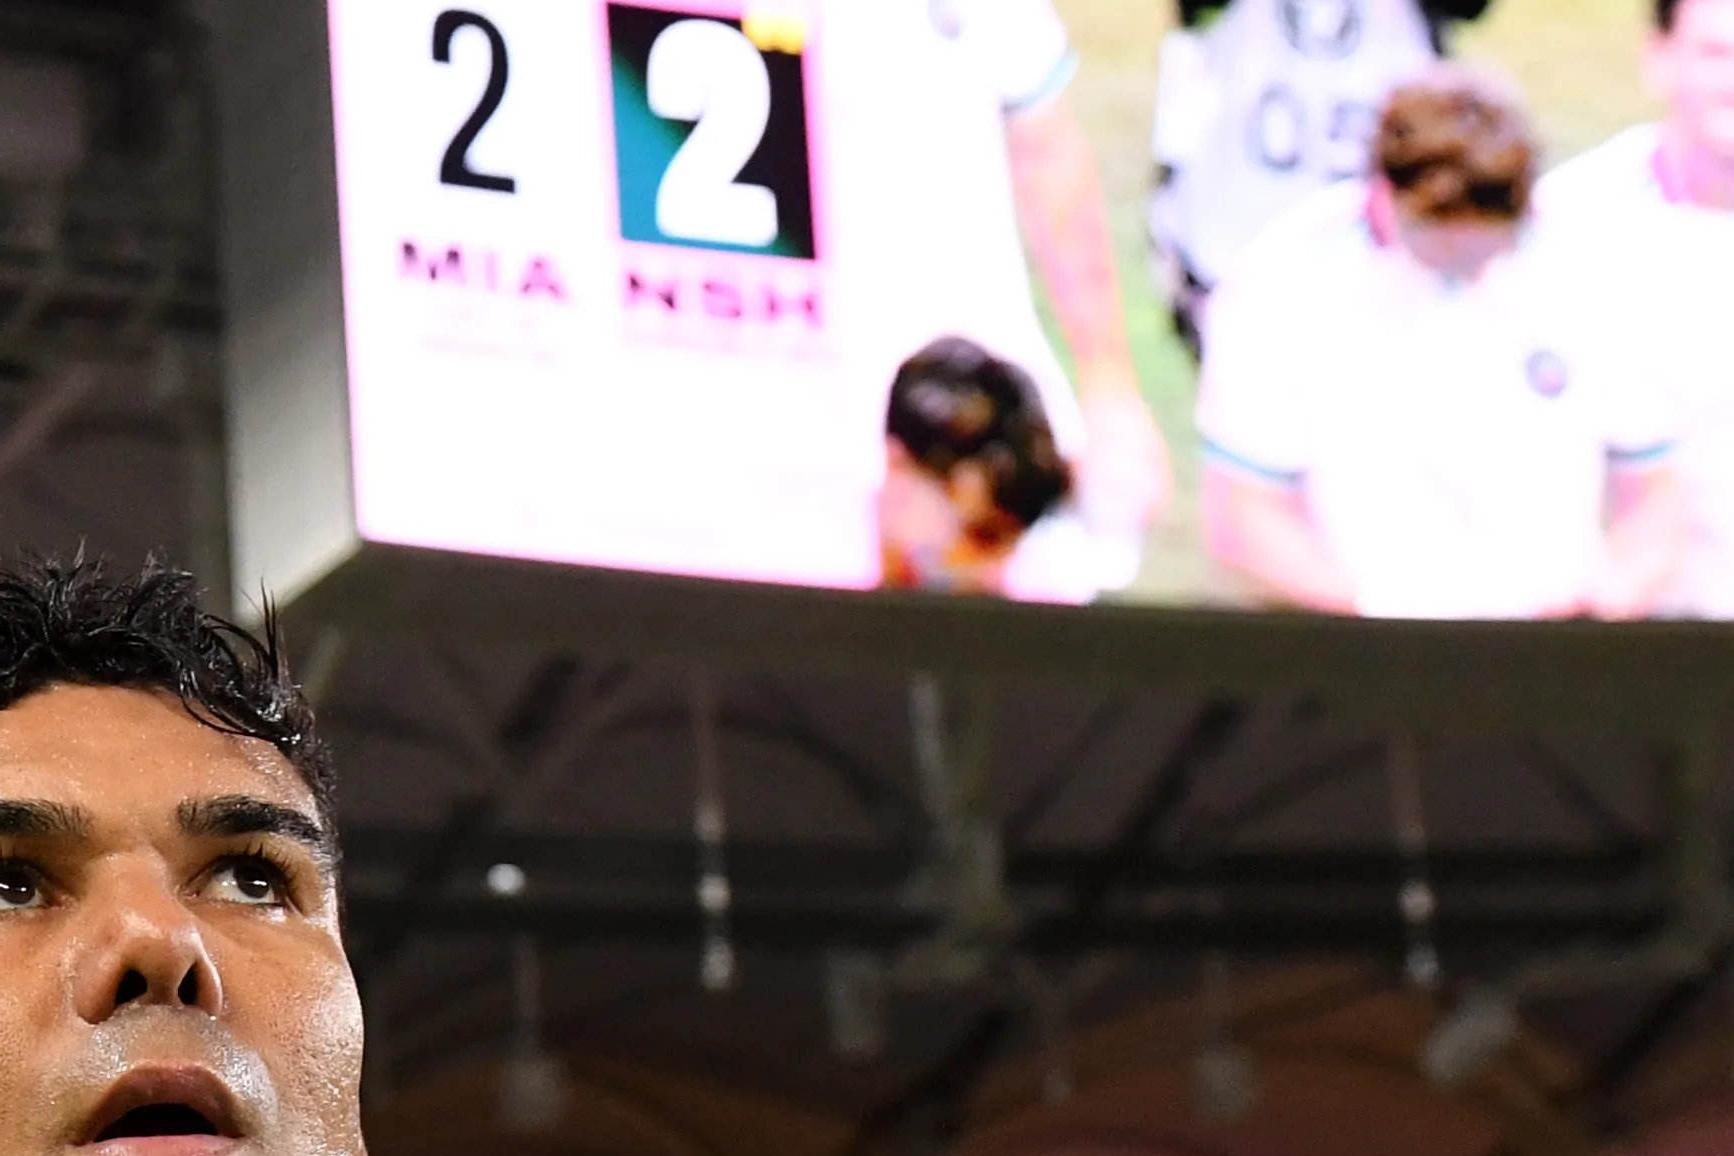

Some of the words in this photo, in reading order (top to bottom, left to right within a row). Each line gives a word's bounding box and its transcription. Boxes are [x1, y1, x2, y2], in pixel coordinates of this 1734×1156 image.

[430, 8, 518, 195] 2
[646, 17, 779, 248] 2
[398, 240, 568, 302] MIA
[623, 270, 822, 330] NSH
